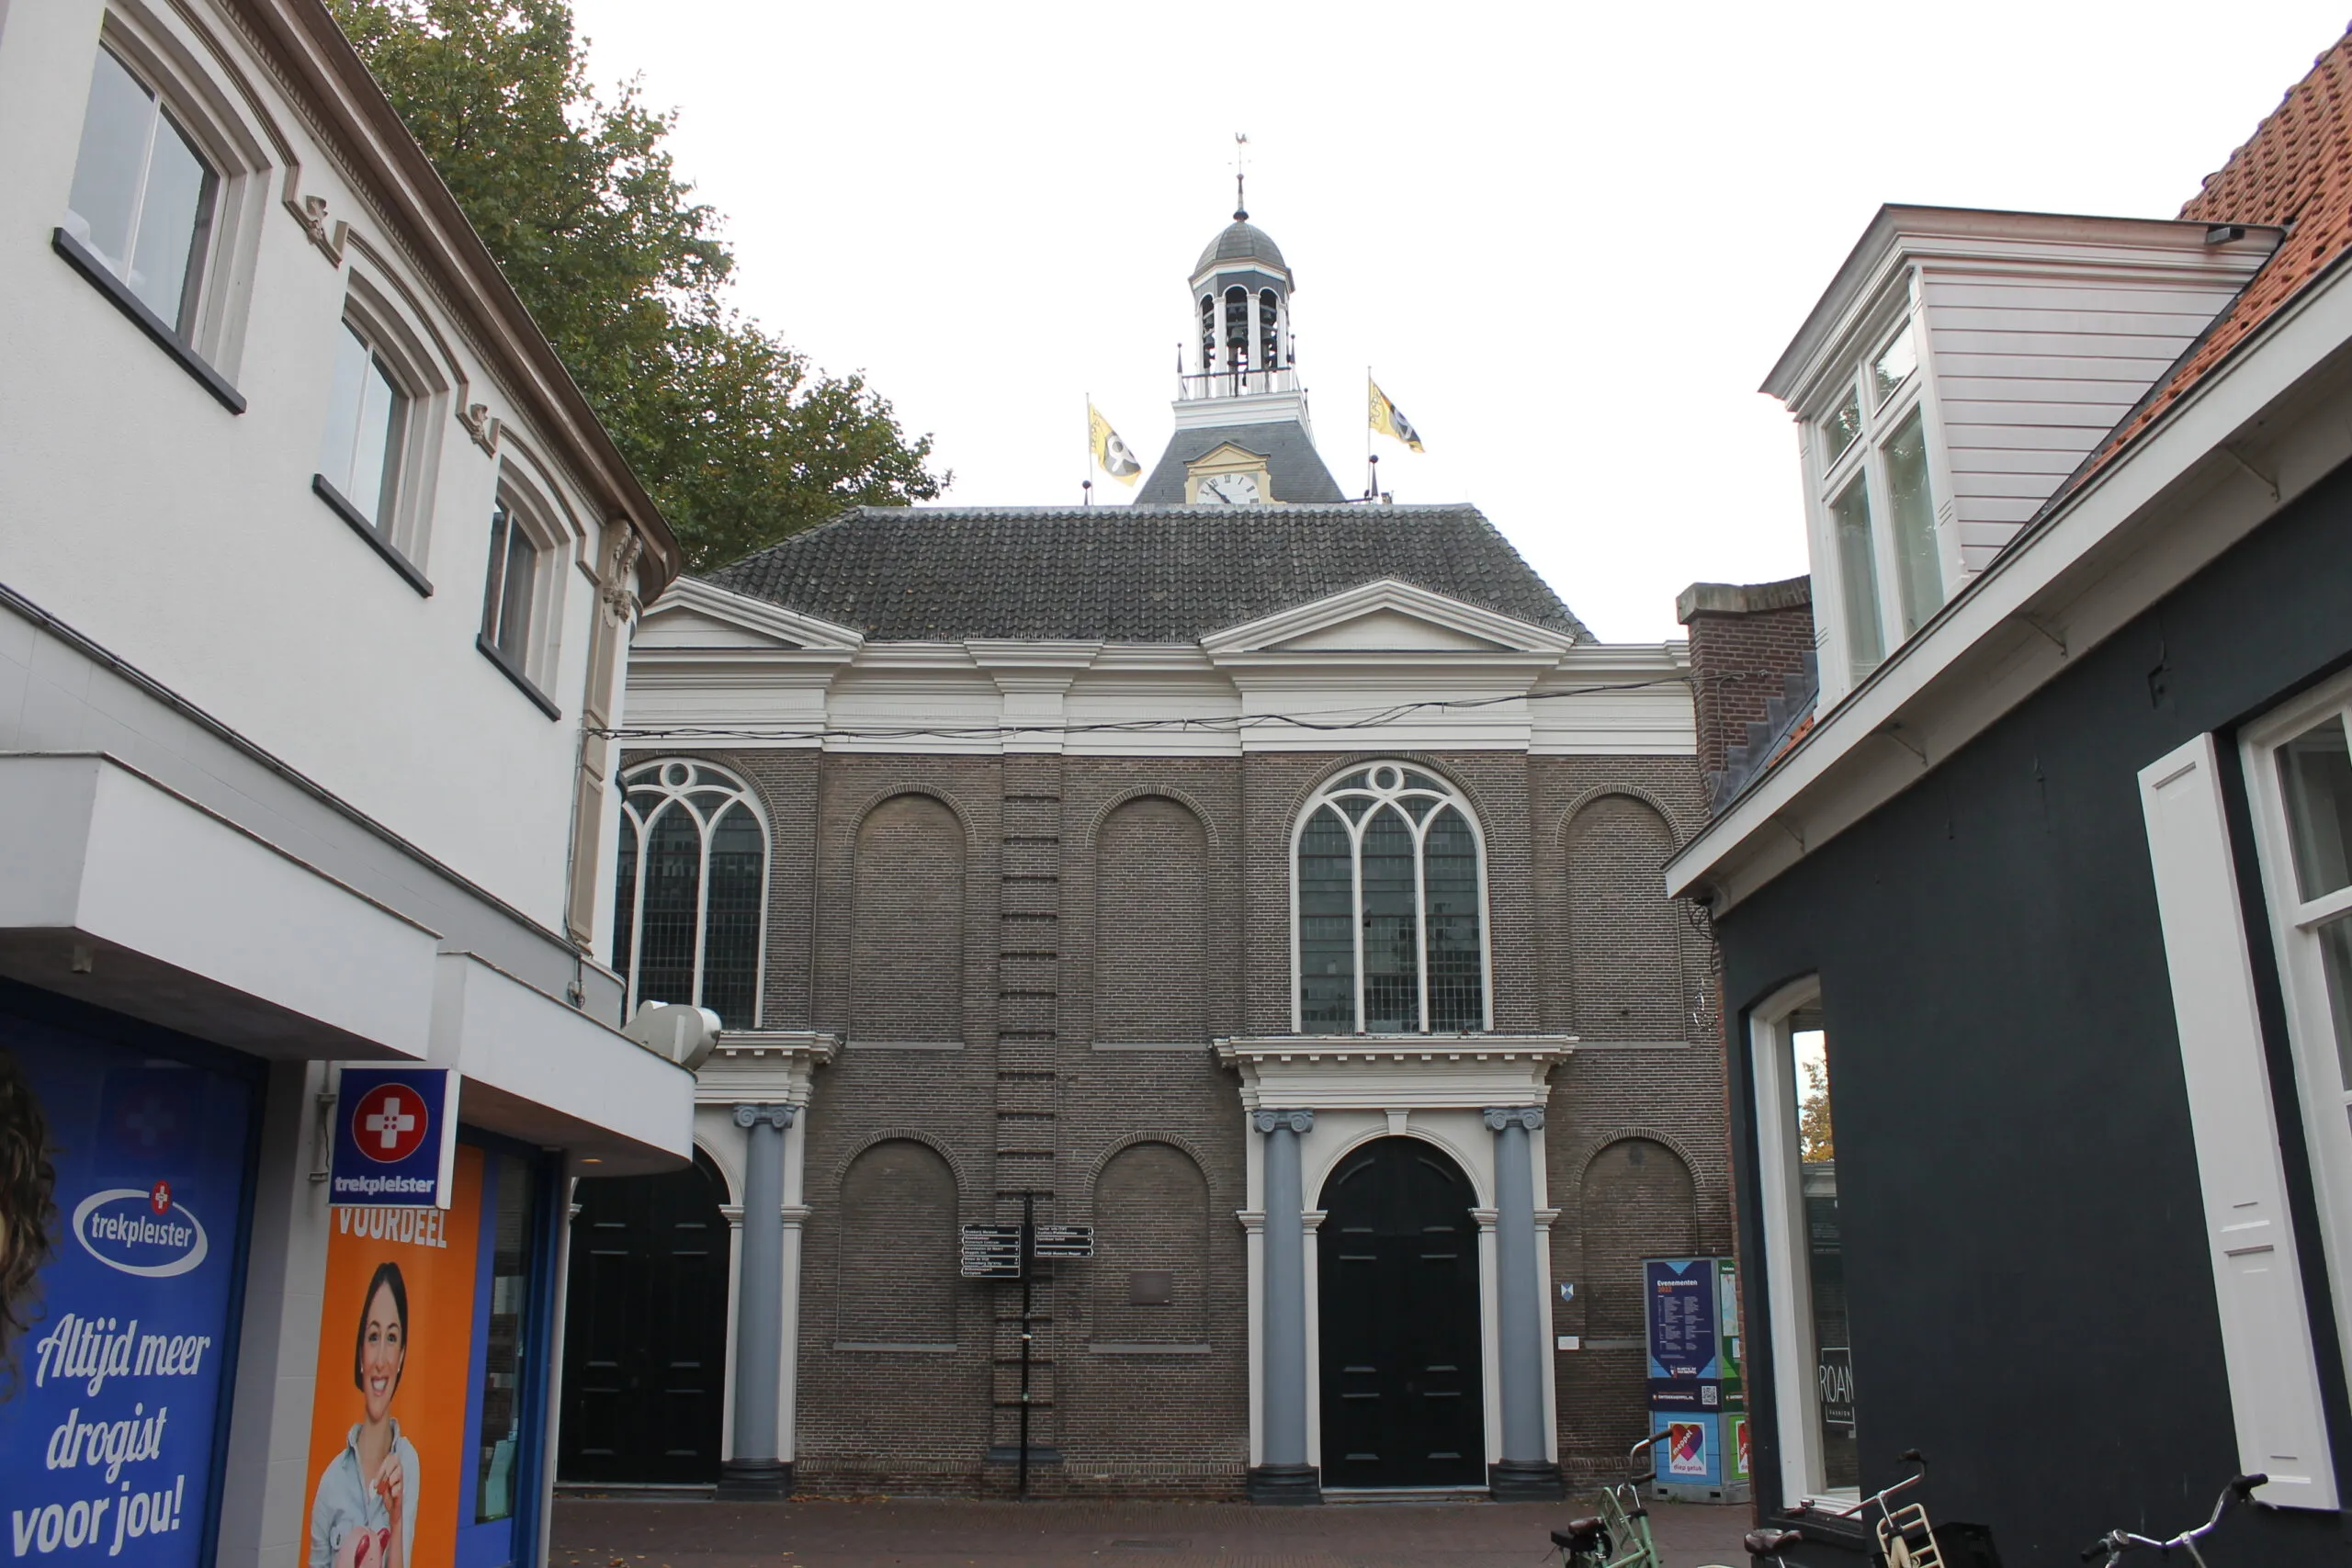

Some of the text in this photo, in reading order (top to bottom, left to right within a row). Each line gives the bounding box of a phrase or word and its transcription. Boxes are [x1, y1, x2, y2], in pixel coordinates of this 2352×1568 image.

[334, 1175, 435, 1195] trekpleister
[92, 1213, 192, 1248] trekpleister
[36, 1313, 211, 1396] Altijd meer
[1819, 1365, 1855, 1403] ROAN
[46, 1402, 167, 1483] drogist
[1672, 1429, 1693, 1456] meppel
[12, 1474, 185, 1557] voor jou!
